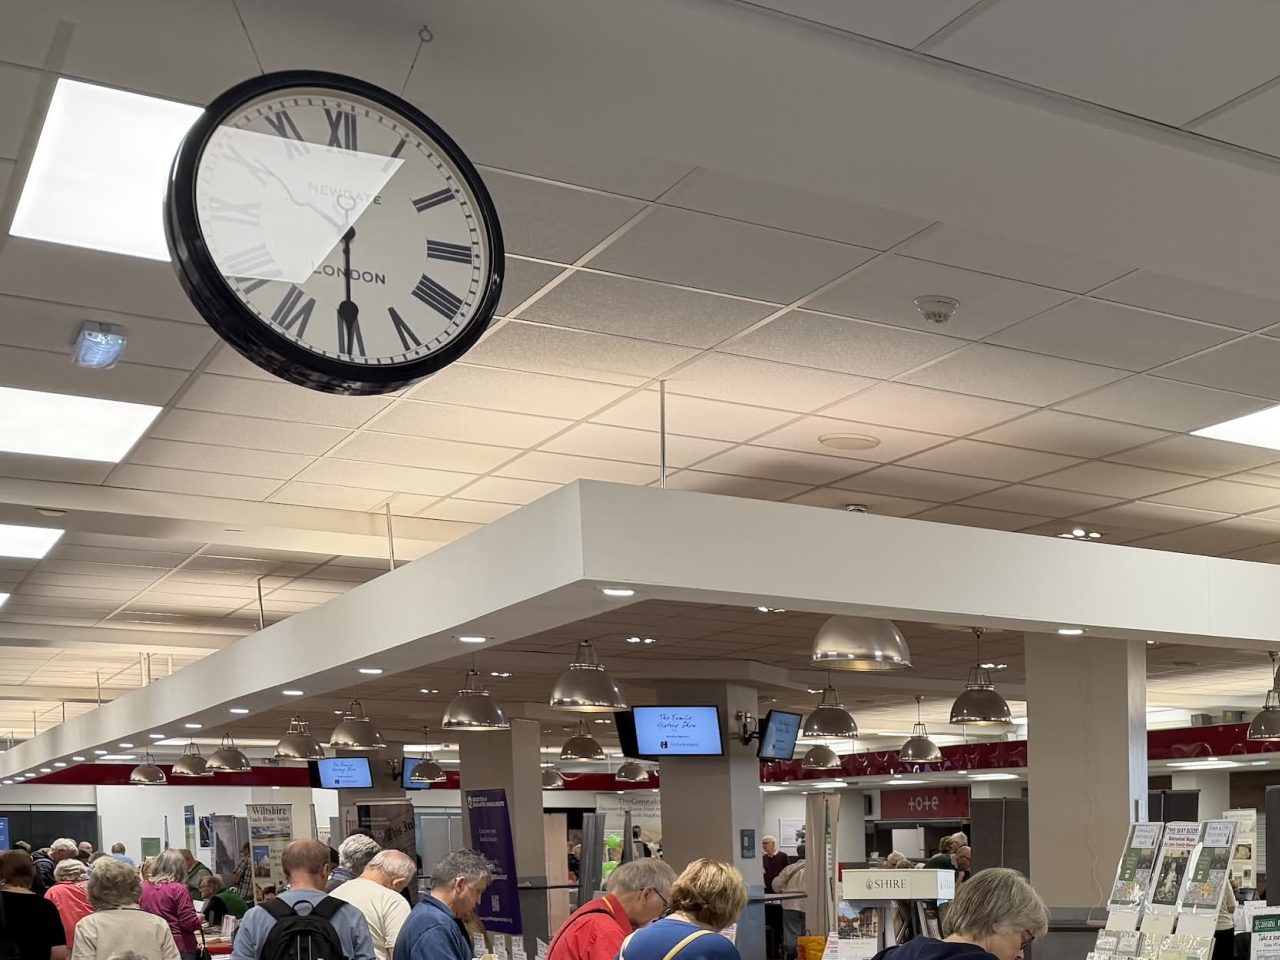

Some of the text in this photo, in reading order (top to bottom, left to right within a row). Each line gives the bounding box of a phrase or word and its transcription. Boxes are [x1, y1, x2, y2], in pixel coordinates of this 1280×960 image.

[308, 182, 382, 206] NEWGATE
[312, 262, 386, 285] LONDON
[252, 806, 287, 815] Wiltshire
[908, 796, 939, 811] tote
[874, 880, 907, 889] SHIRE
